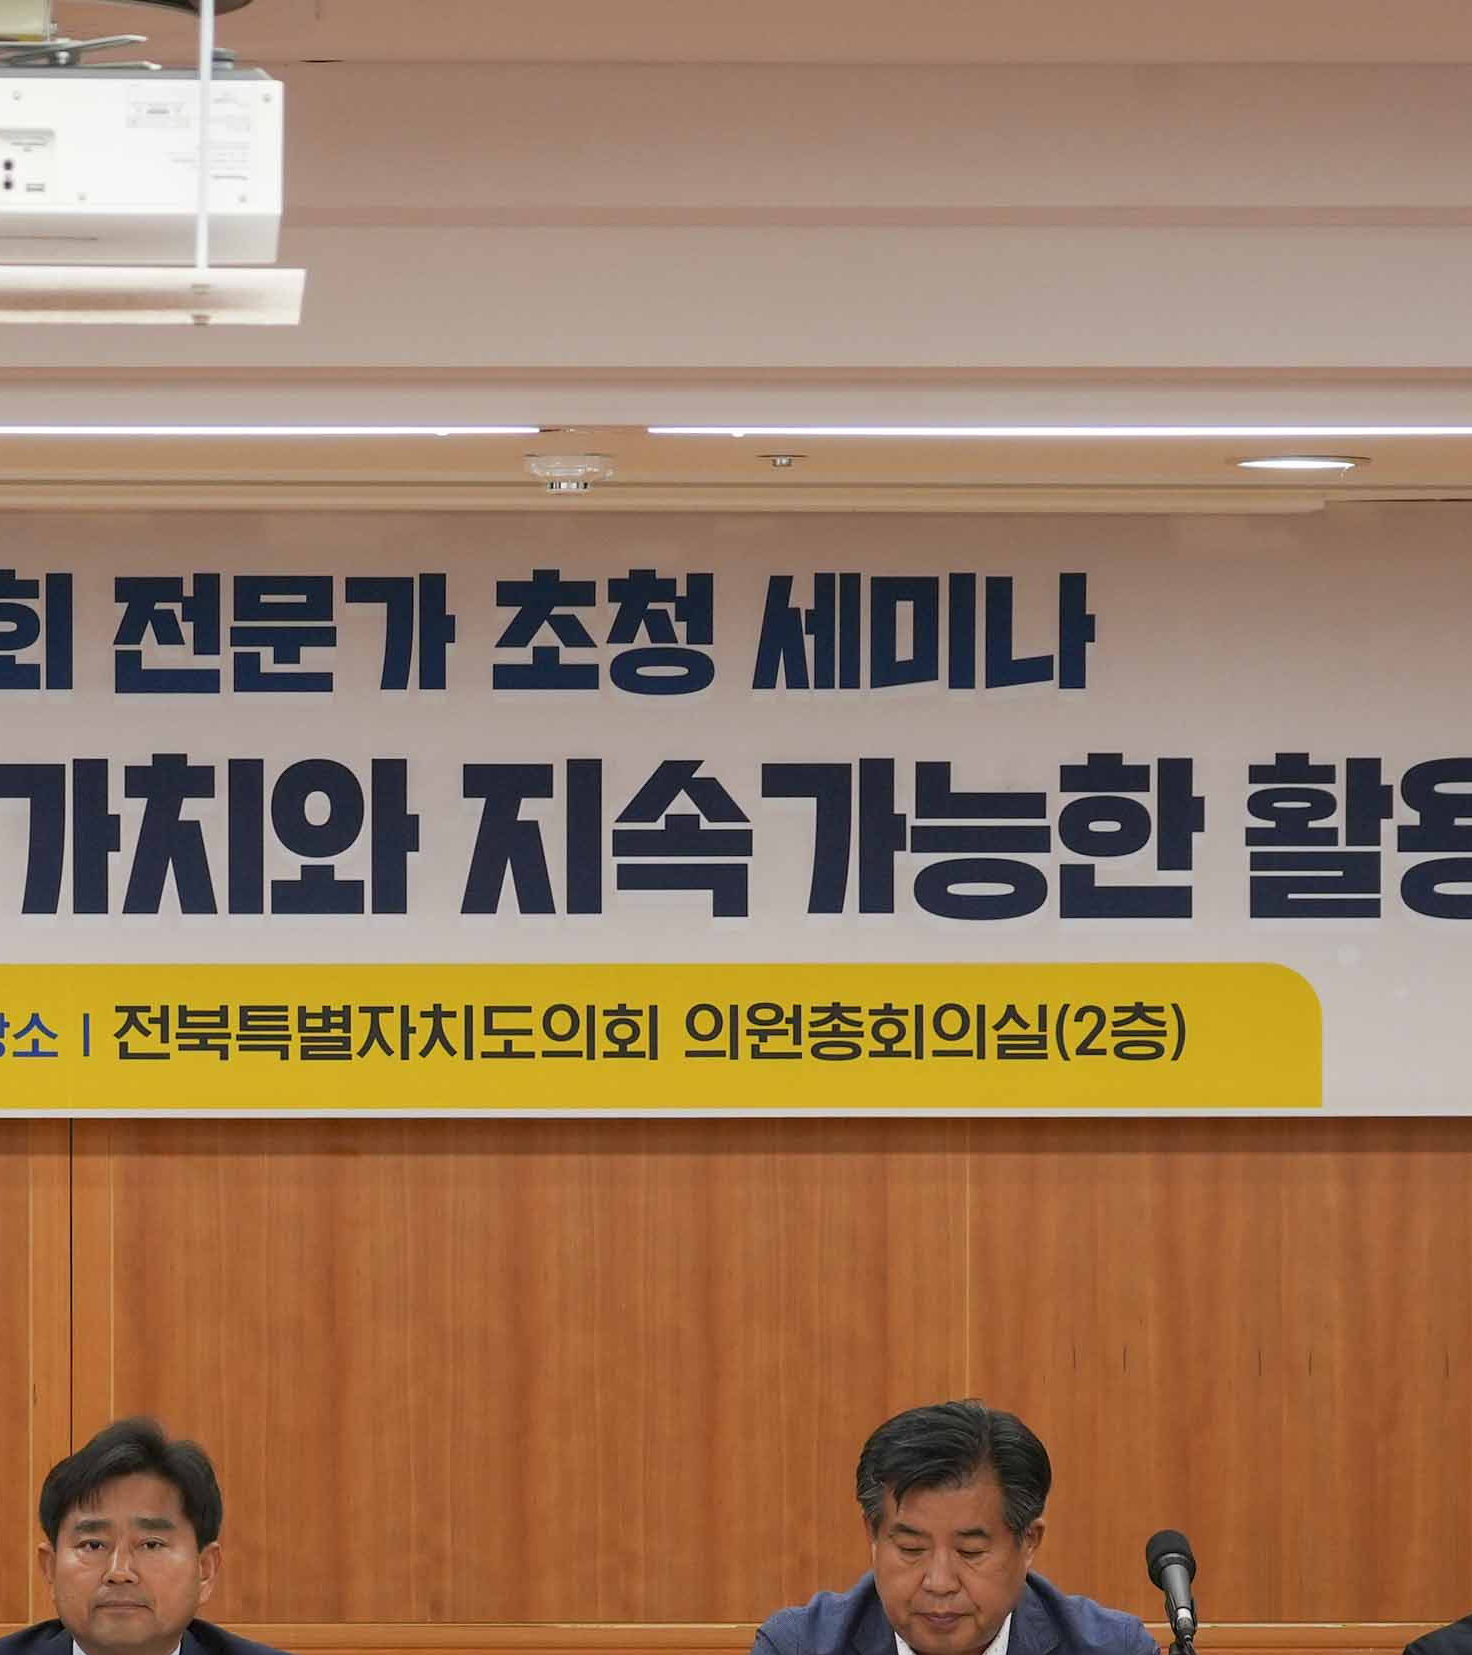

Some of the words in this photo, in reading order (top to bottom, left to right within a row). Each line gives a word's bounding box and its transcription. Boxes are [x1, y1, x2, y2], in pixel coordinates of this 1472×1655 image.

[113, 573, 455, 693] 전문가
[493, 569, 714, 695] 초청
[752, 572, 1095, 689] 세미나
[461, 753, 1205, 920] 지속가능한
[114, 1004, 658, 1060] 전북특별자치도의회
[685, 1002, 1185, 1061] 의원총회의실(2층)
